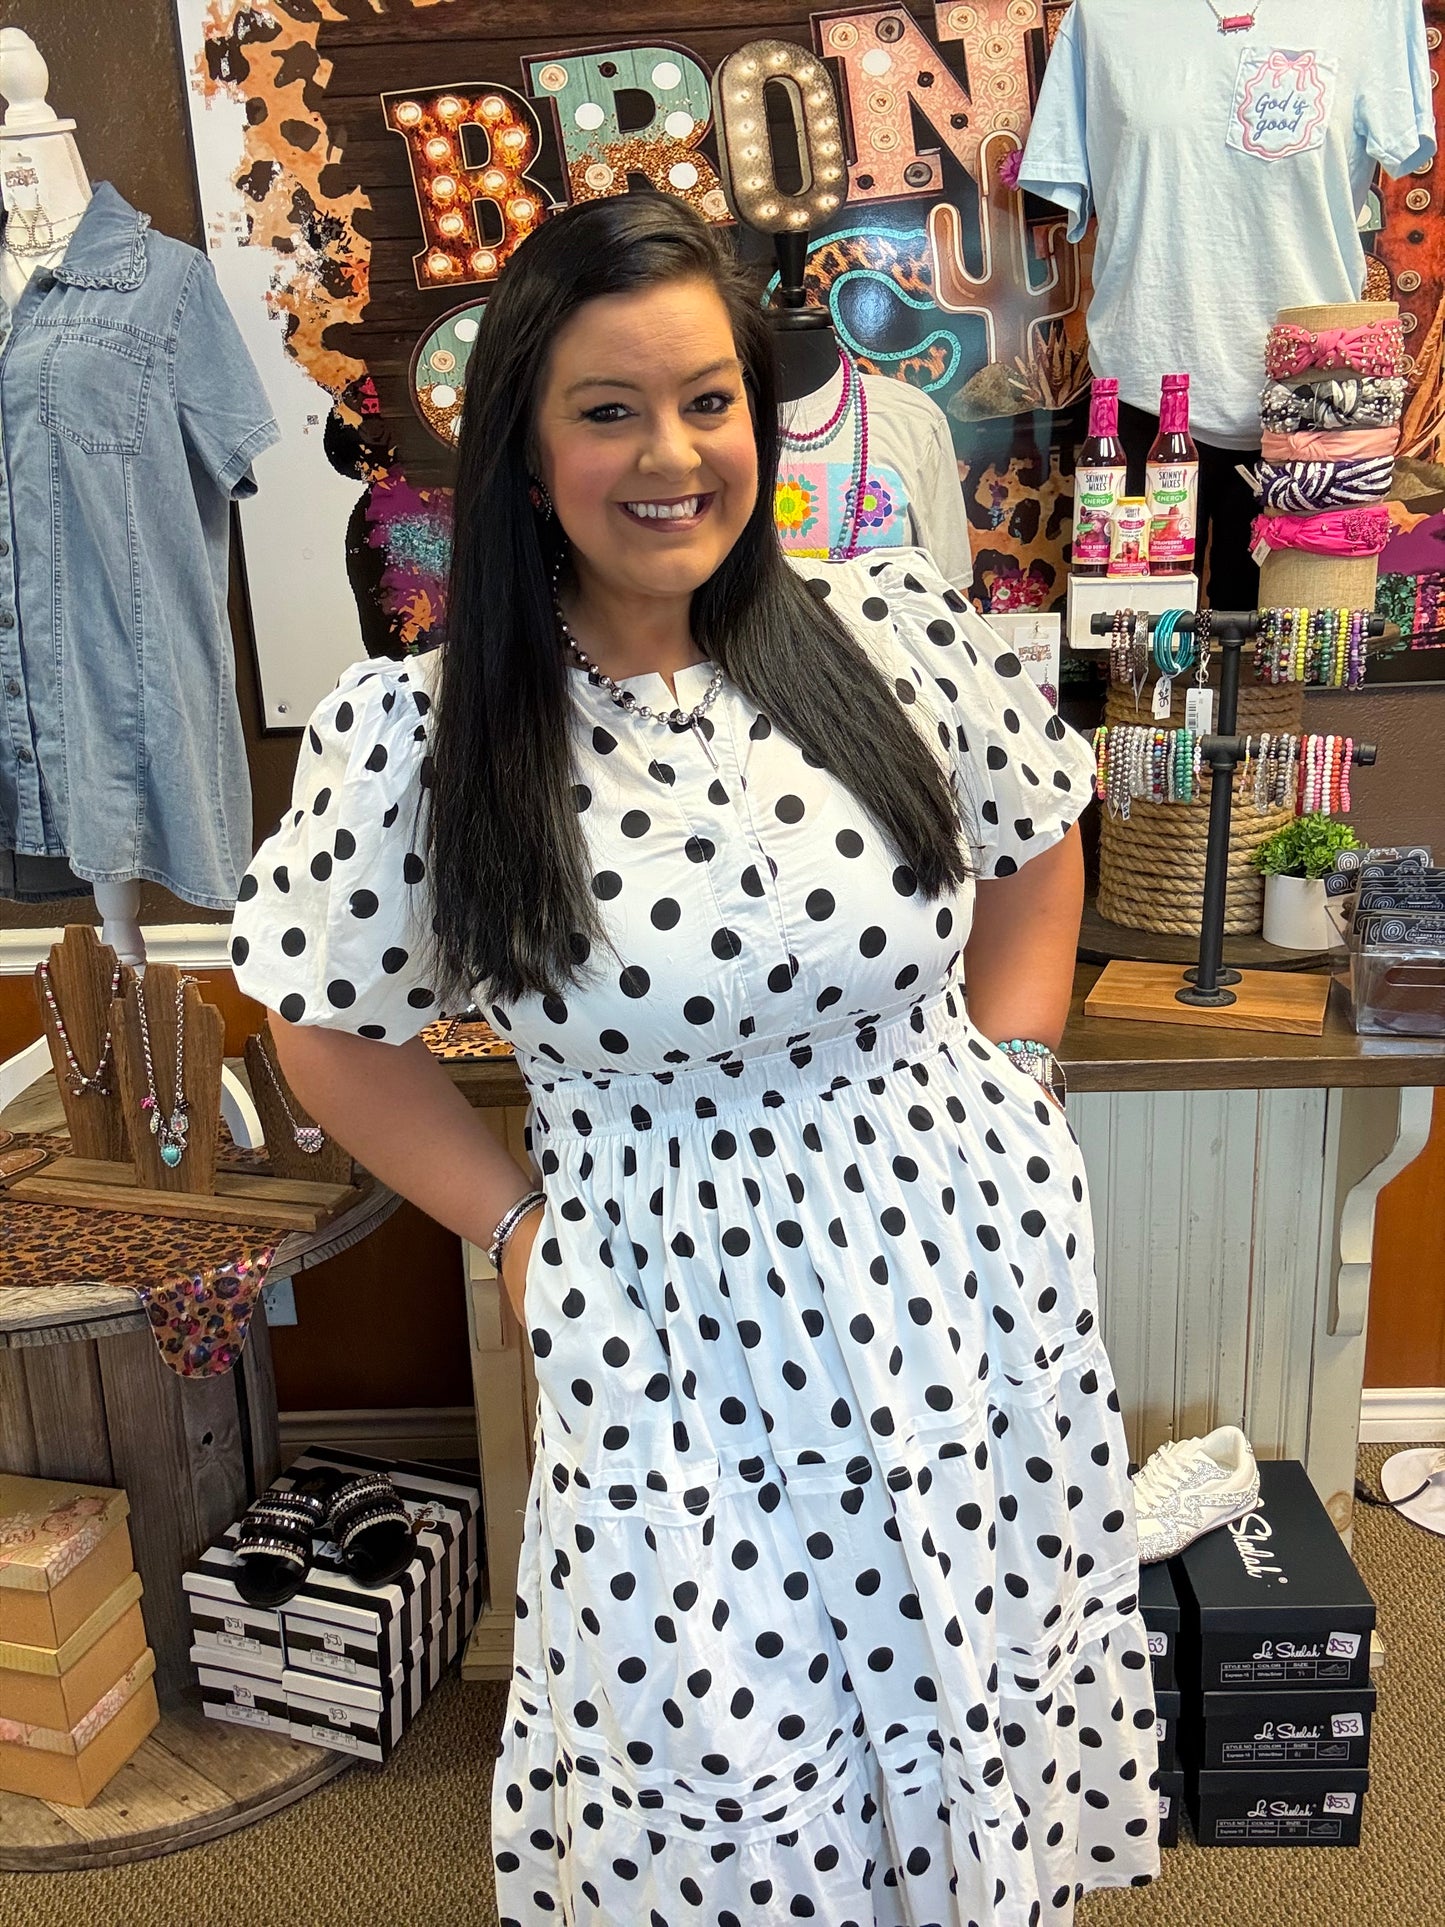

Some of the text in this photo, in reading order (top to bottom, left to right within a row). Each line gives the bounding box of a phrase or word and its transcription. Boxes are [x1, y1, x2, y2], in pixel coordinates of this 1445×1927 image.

[1255, 90, 1310, 119] God is
[1252, 111, 1304, 141] good
[379, 0, 1060, 290] BRON
[1085, 474, 1108, 483] SKINNY
[1158, 470, 1183, 481] SKINNY
[1088, 483, 1107, 491] MIXES
[1161, 480, 1181, 489] MIXES
[1083, 497, 1110, 505] ENERGY
[1156, 494, 1184, 502] ENERGY
[323, 1632, 343, 1646] $50
[1148, 1637, 1165, 1653] 53
[1329, 1638, 1355, 1655] $53
[1332, 1719, 1359, 1734] $53
[1326, 1795, 1351, 1809] $53
